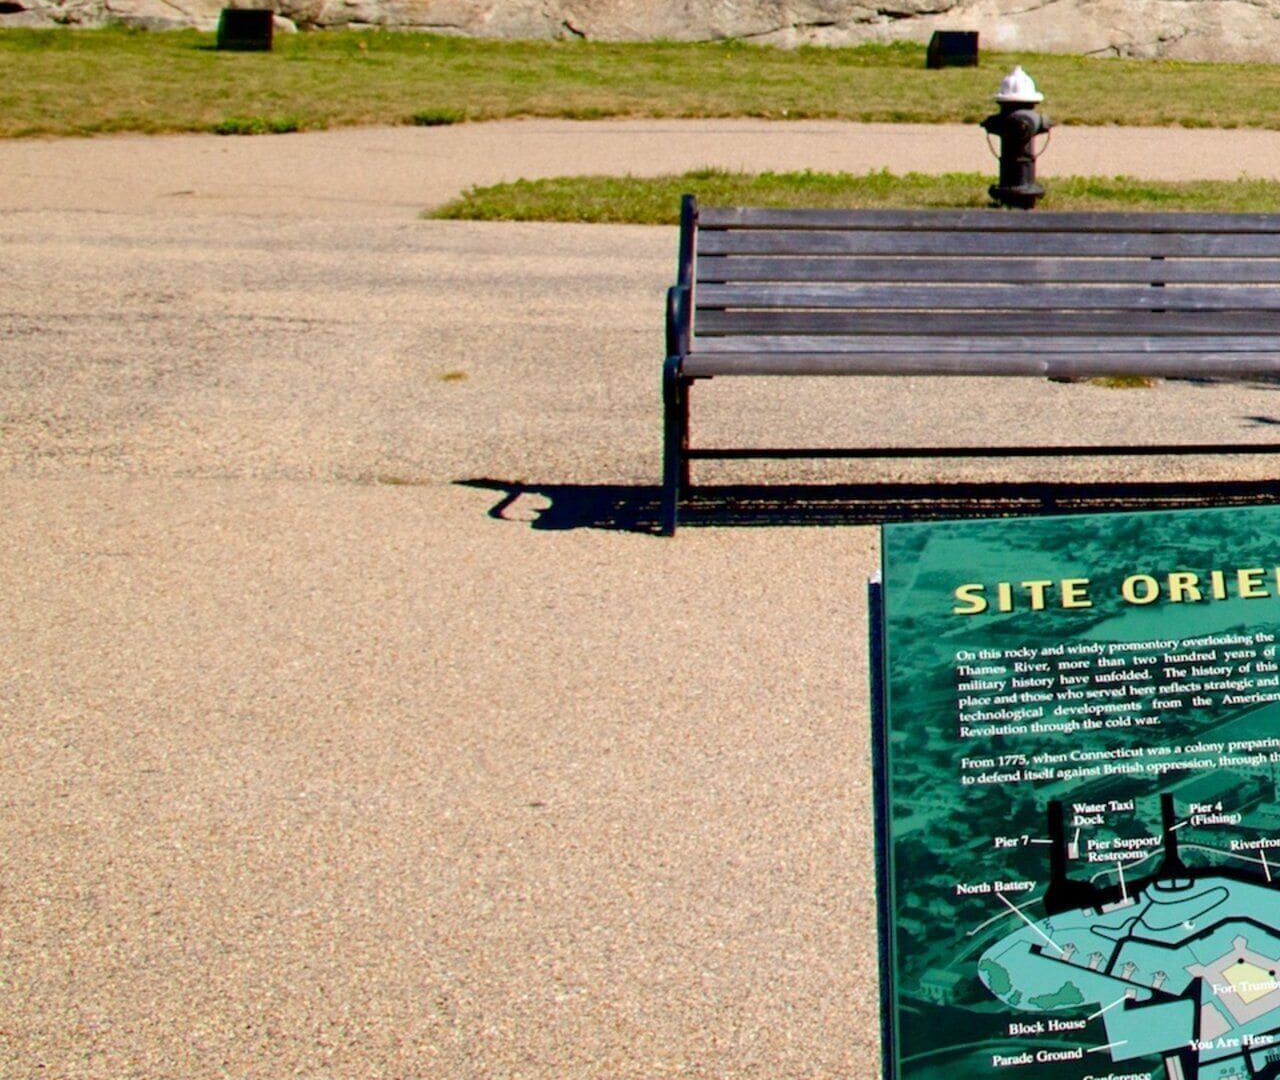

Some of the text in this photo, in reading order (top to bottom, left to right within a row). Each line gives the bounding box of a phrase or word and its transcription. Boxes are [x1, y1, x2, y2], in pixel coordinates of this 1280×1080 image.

[953, 577, 1092, 614] SITE
[956, 631, 1274, 660] On this rocky and windy promontory overlooking the
[957, 646, 1276, 675] Thames River, more than two hundred years of
[958, 661, 1277, 690] military history have unfolded. The history of this
[958, 675, 1279, 708] place and those who served here reflects strategic and
[959, 691, 1280, 720] technological developments from the American
[960, 715, 1160, 736] Revolution through the cold war.
[961, 757, 994, 767] From
[999, 753, 1029, 765] 1775,
[1033, 752, 1068, 763] when
[1069, 746, 1143, 760] Connecticut
[1148, 747, 1171, 755] was
[1184, 742, 1224, 754] colony
[962, 773, 975, 783] to
[976, 769, 1021, 782] defend
[1024, 767, 1053, 779] itself
[1056, 764, 1100, 779] against
[1104, 761, 1144, 774] British
[1146, 757, 1216, 773] oppression,
[1219, 752, 1267, 766] through
[1073, 799, 1134, 812] Water Taxi
[1189, 801, 1213, 812] Pier
[1074, 813, 1104, 824] Dock
[1191, 811, 1241, 826] (Fishing)
[995, 836, 1017, 846] Pier
[1087, 834, 1162, 848] Pier Support/
[1088, 849, 1148, 860] Restrooms
[957, 880, 1036, 894] North Battery
[1213, 982, 1237, 993] Fort
[1009, 1020, 1086, 1034] Block House
[1189, 1034, 1274, 1049] You Are Here
[993, 1048, 1083, 1065] Parade Ground
